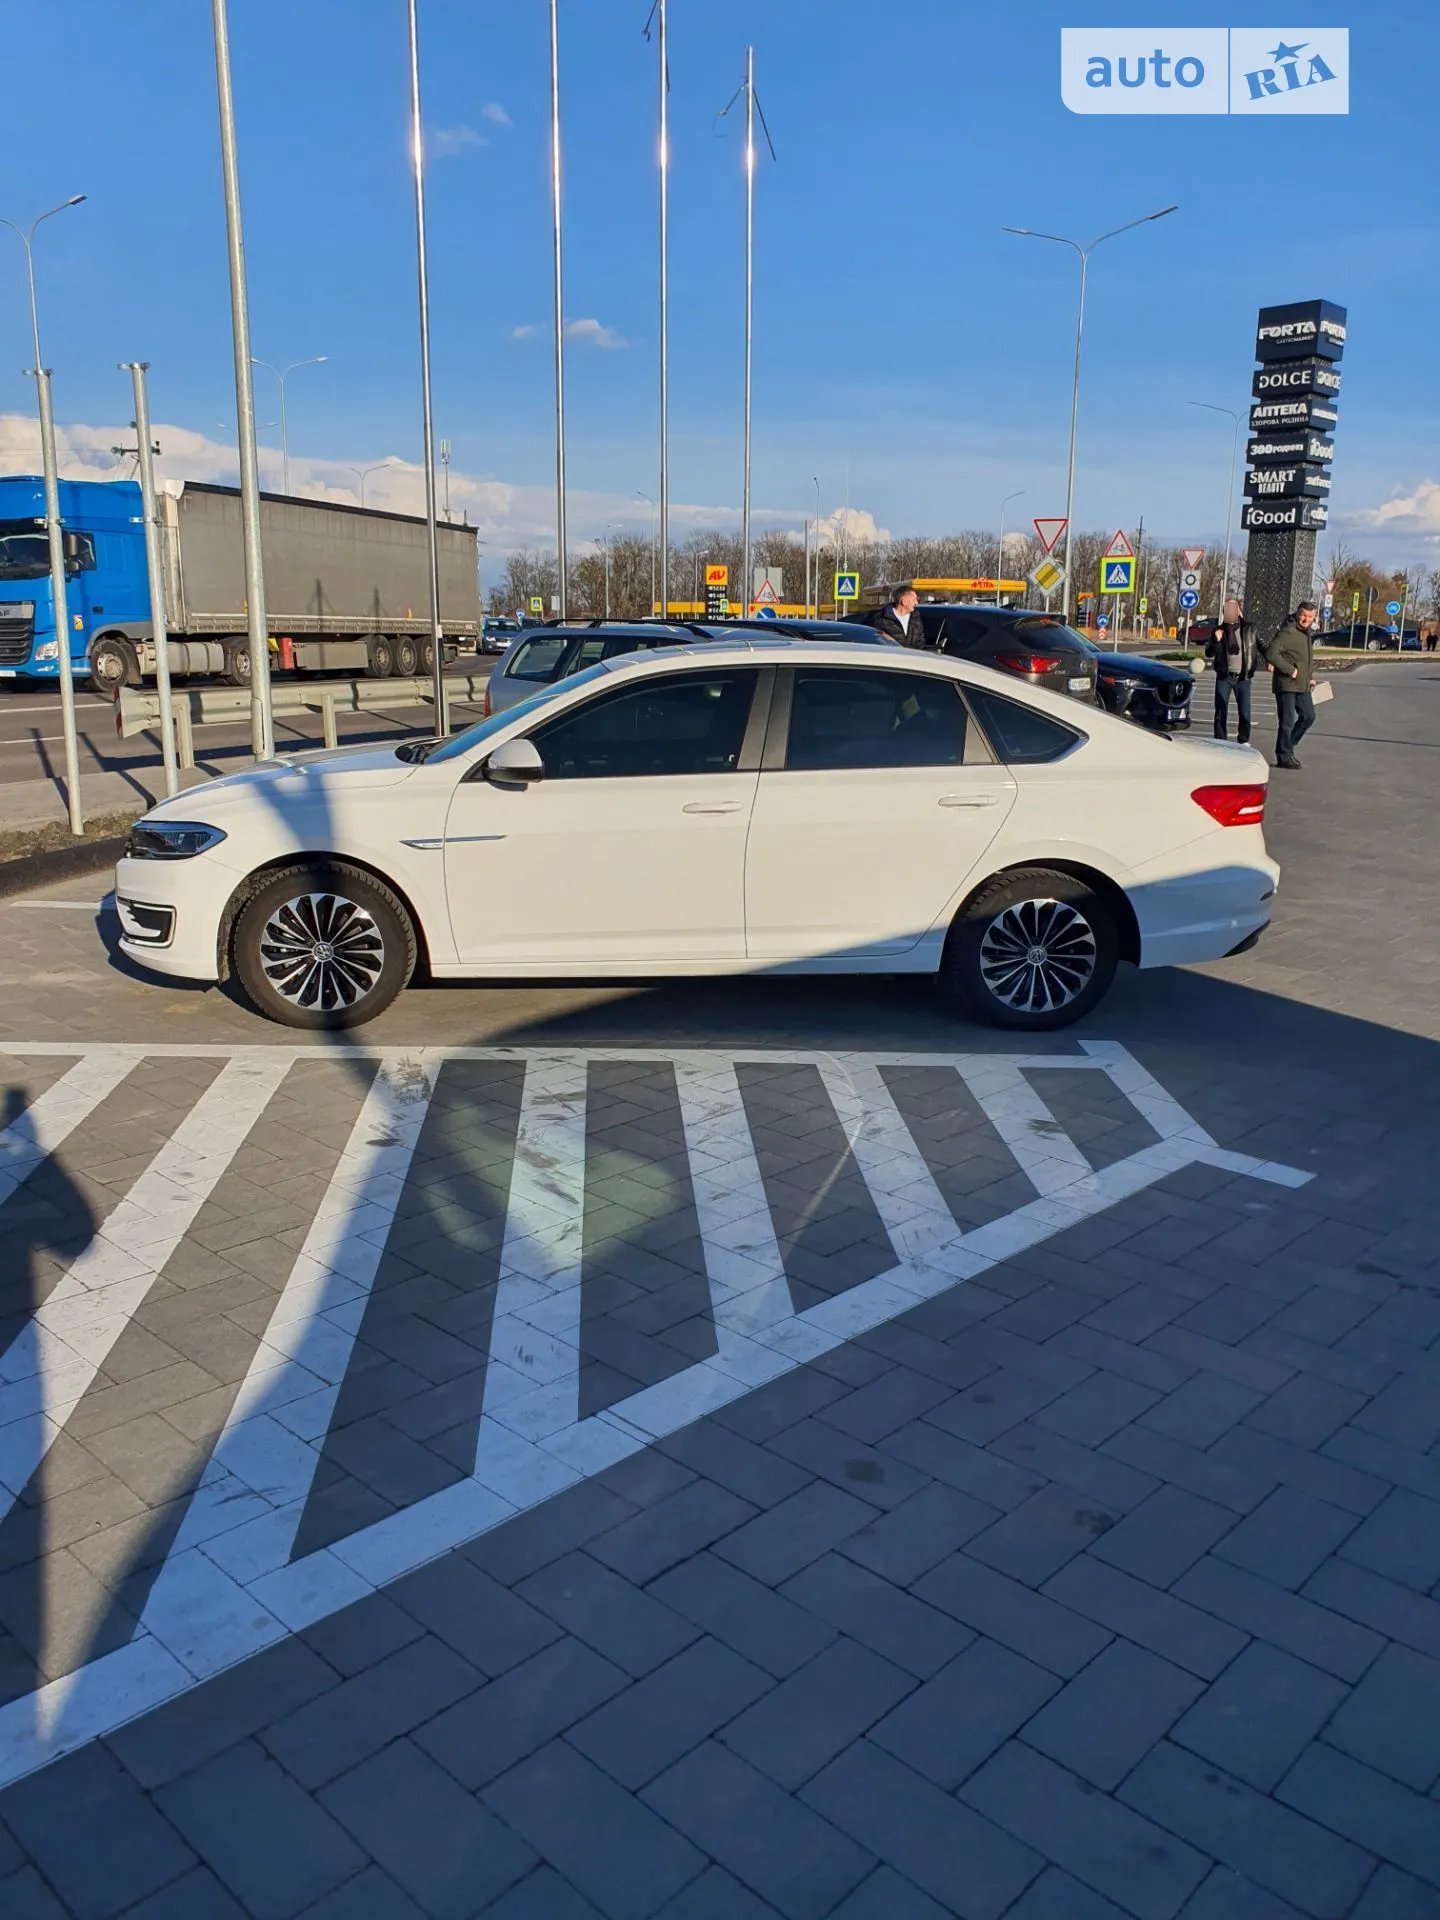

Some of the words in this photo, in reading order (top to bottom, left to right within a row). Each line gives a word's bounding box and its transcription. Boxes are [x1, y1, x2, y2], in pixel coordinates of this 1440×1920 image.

[1259, 370, 1311, 389] DOLCE
[1317, 371, 1341, 389] DOLCE
[1253, 403, 1308, 418] АПТЕКА
[1250, 470, 1296, 484] SMART
[1258, 482, 1285, 494] BEAUTY
[1246, 508, 1296, 525] iGood
